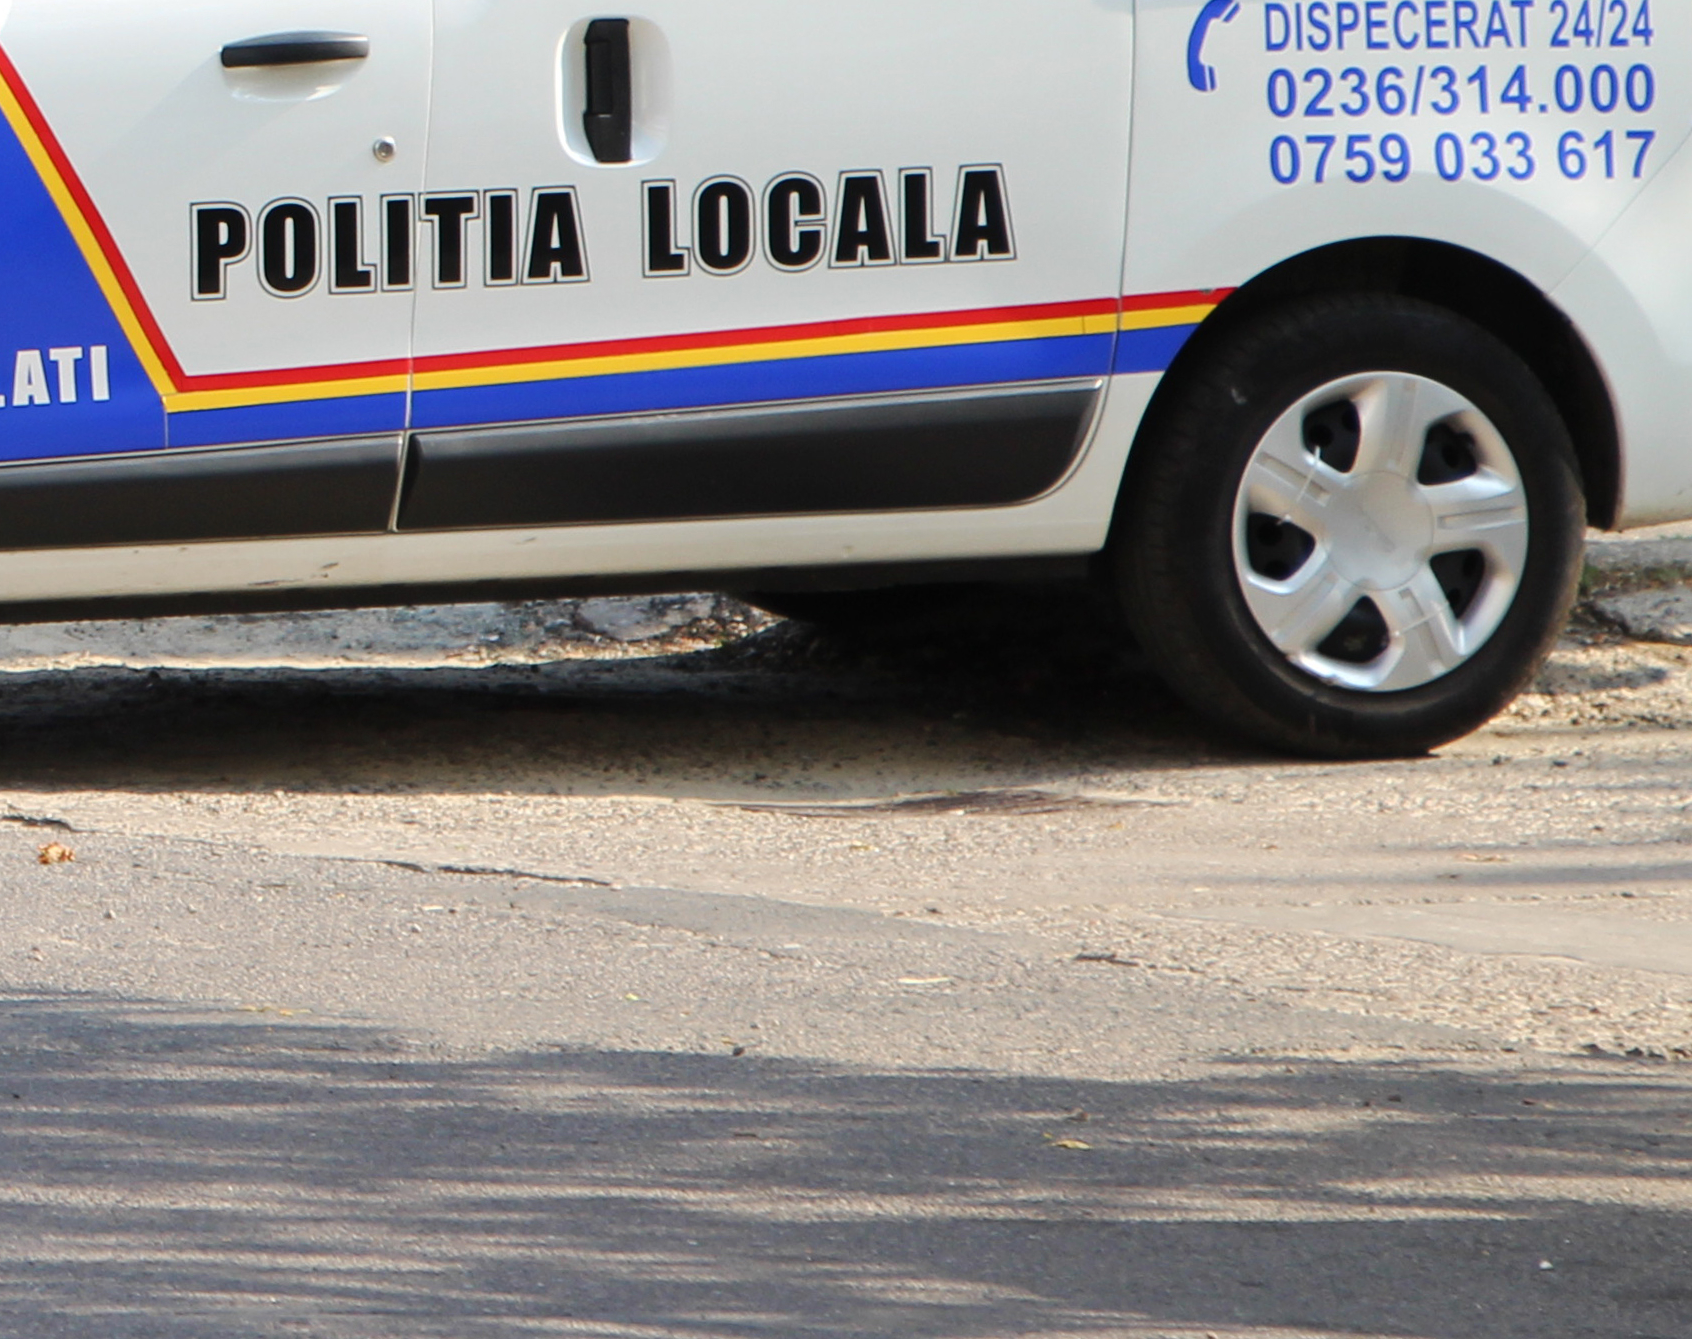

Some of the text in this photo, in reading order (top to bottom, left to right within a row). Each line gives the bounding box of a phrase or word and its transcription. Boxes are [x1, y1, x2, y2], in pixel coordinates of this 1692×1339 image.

[1264, 0, 1535, 51] DISPECERAT
[1266, 63, 1656, 118] 0236/314.000
[1269, 129, 1656, 185] 0759 033 617
[189, 162, 1018, 302] POLITIA LOCALA
